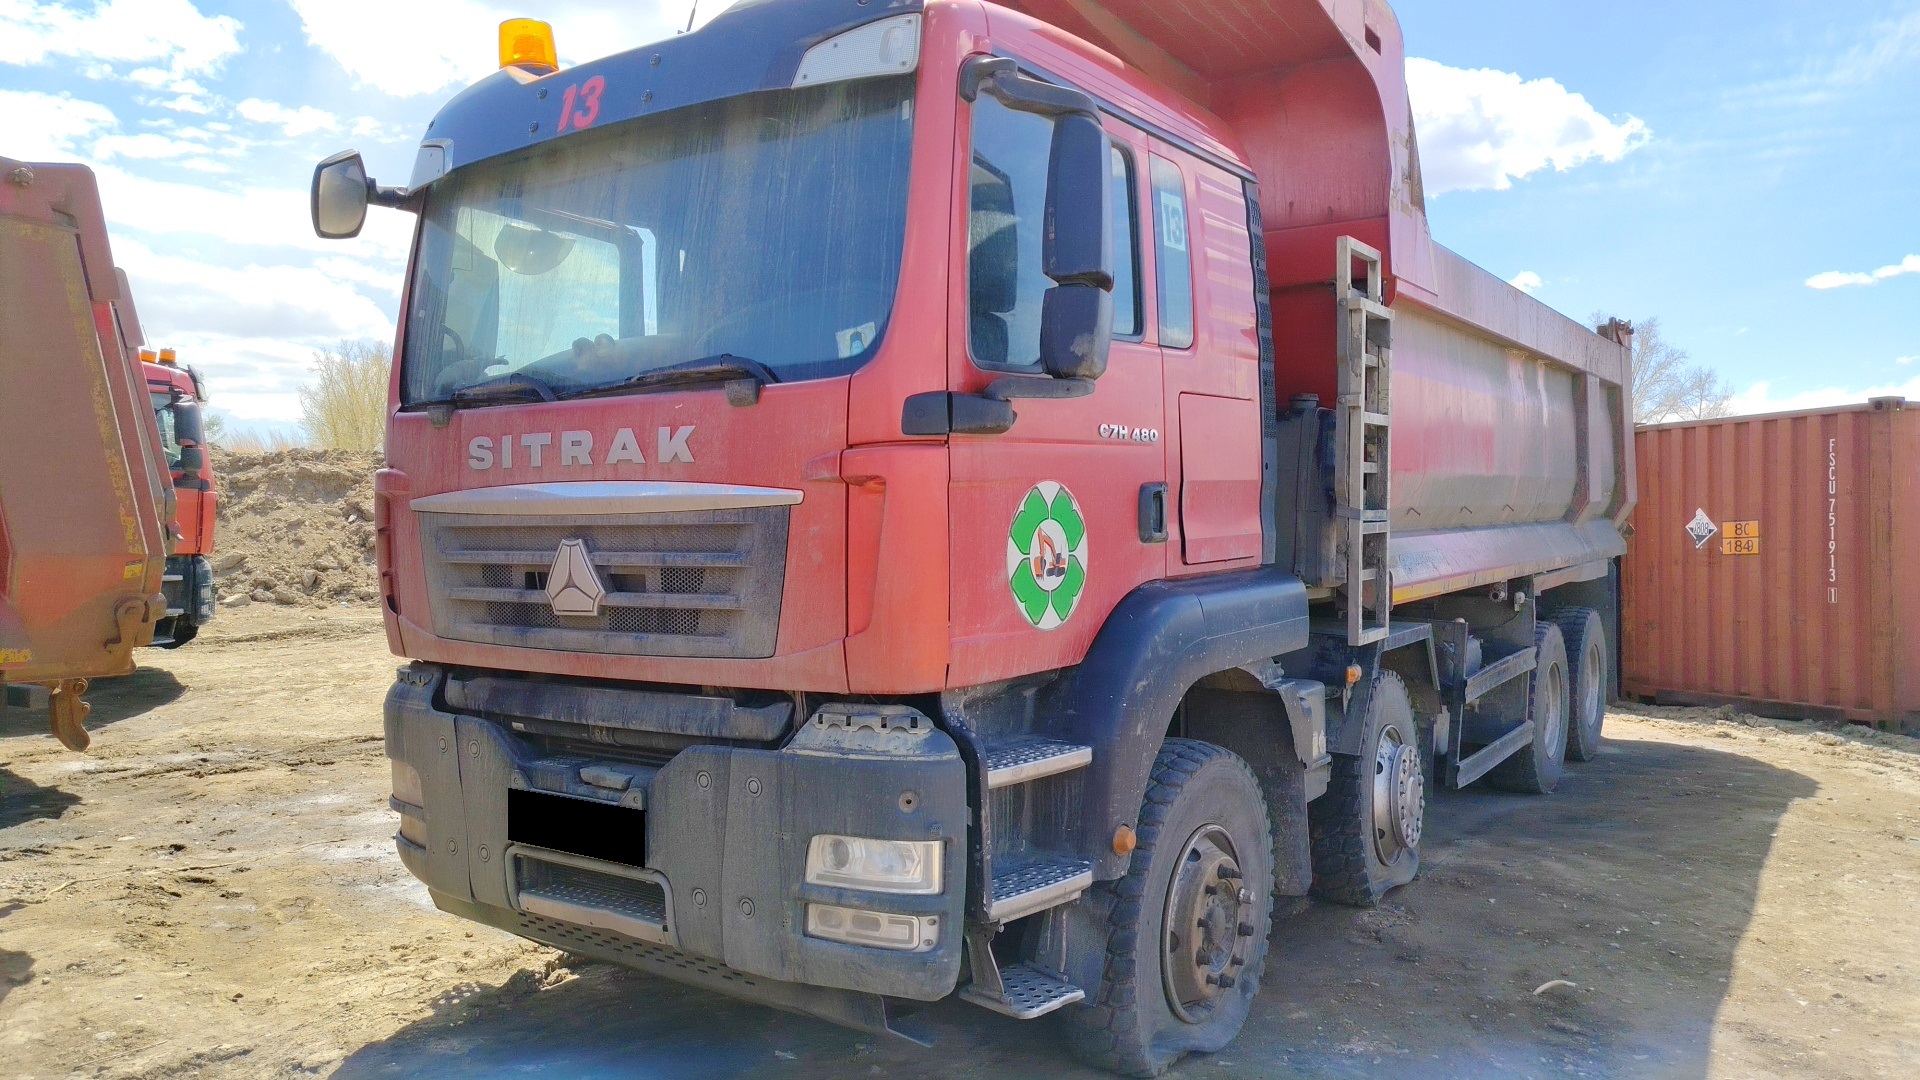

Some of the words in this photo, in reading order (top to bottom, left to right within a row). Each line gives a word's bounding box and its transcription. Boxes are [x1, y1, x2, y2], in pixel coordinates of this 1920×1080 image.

[557, 76, 605, 134] 13
[1163, 202, 1183, 246] 13
[468, 425, 696, 470] SITRAK
[1098, 423, 1128, 440] C7H
[1131, 427, 1158, 442] 480
[1828, 438, 1836, 494] FSCU
[1828, 498, 1836, 582] 751913
